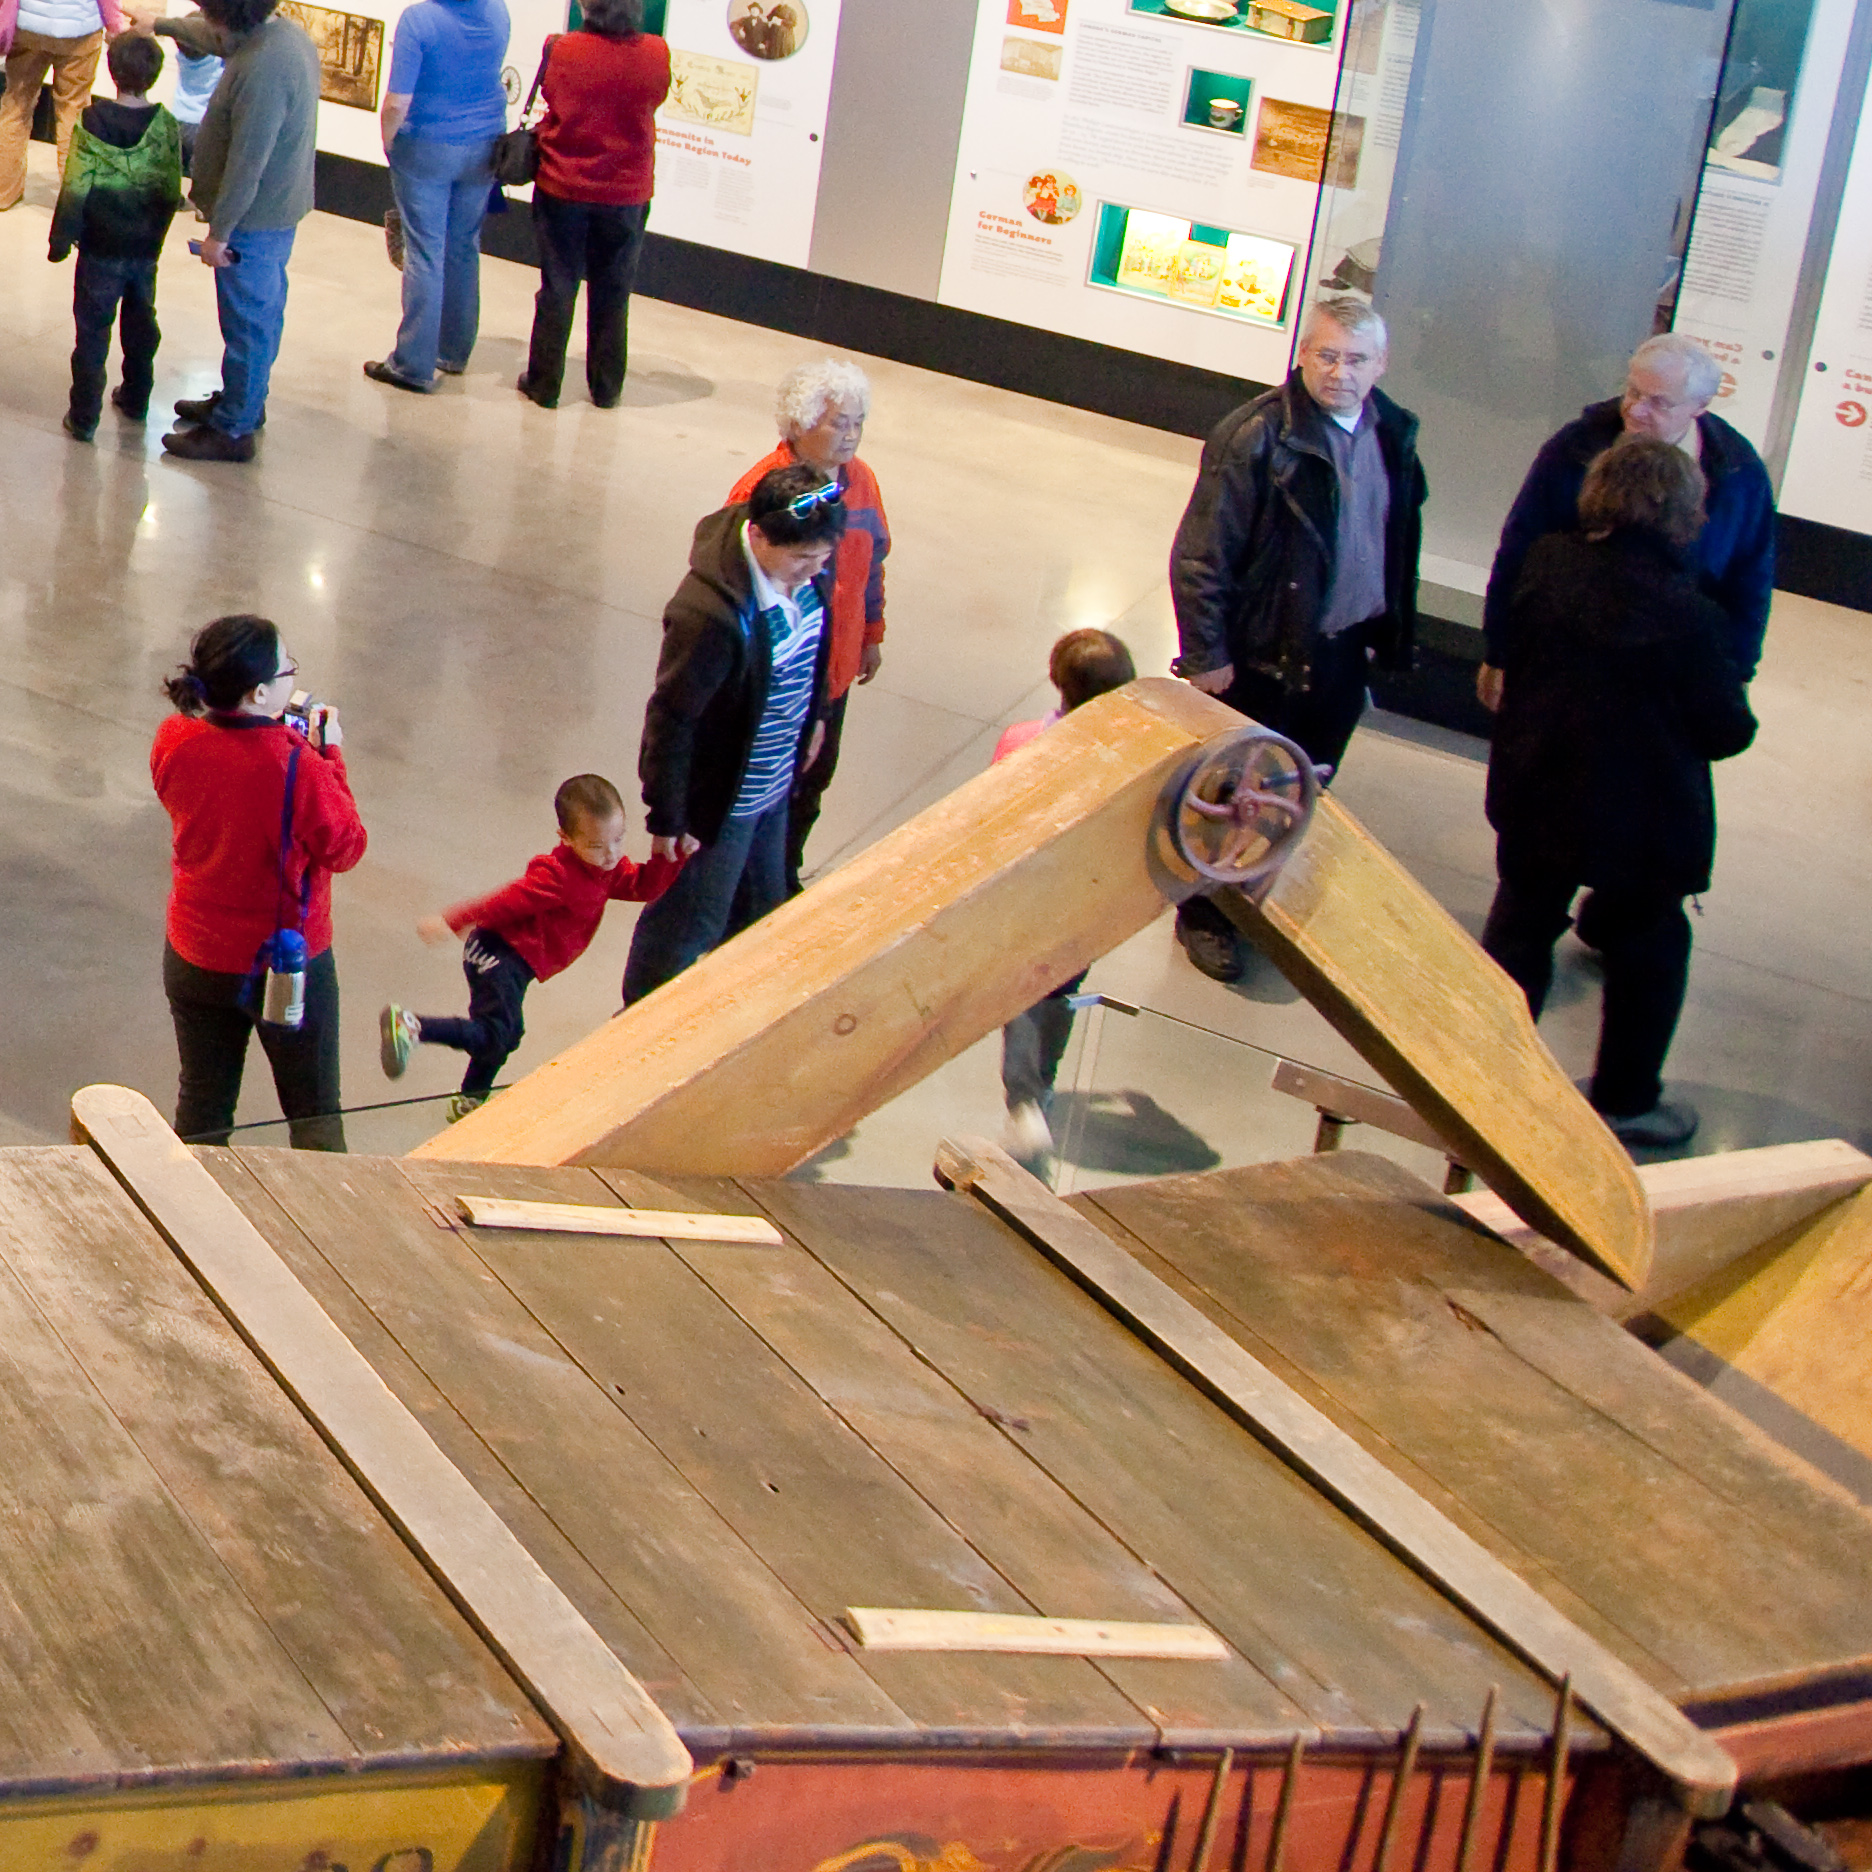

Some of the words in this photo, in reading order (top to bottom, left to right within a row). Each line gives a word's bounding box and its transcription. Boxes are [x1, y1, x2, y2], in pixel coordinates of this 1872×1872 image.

[656, 128, 701, 144] ennonite
[684, 142, 719, 157] Region
[722, 151, 752, 166] Today
[978, 210, 1023, 229] German
[977, 221, 996, 233] for
[996, 224, 1052, 245] Beginners
